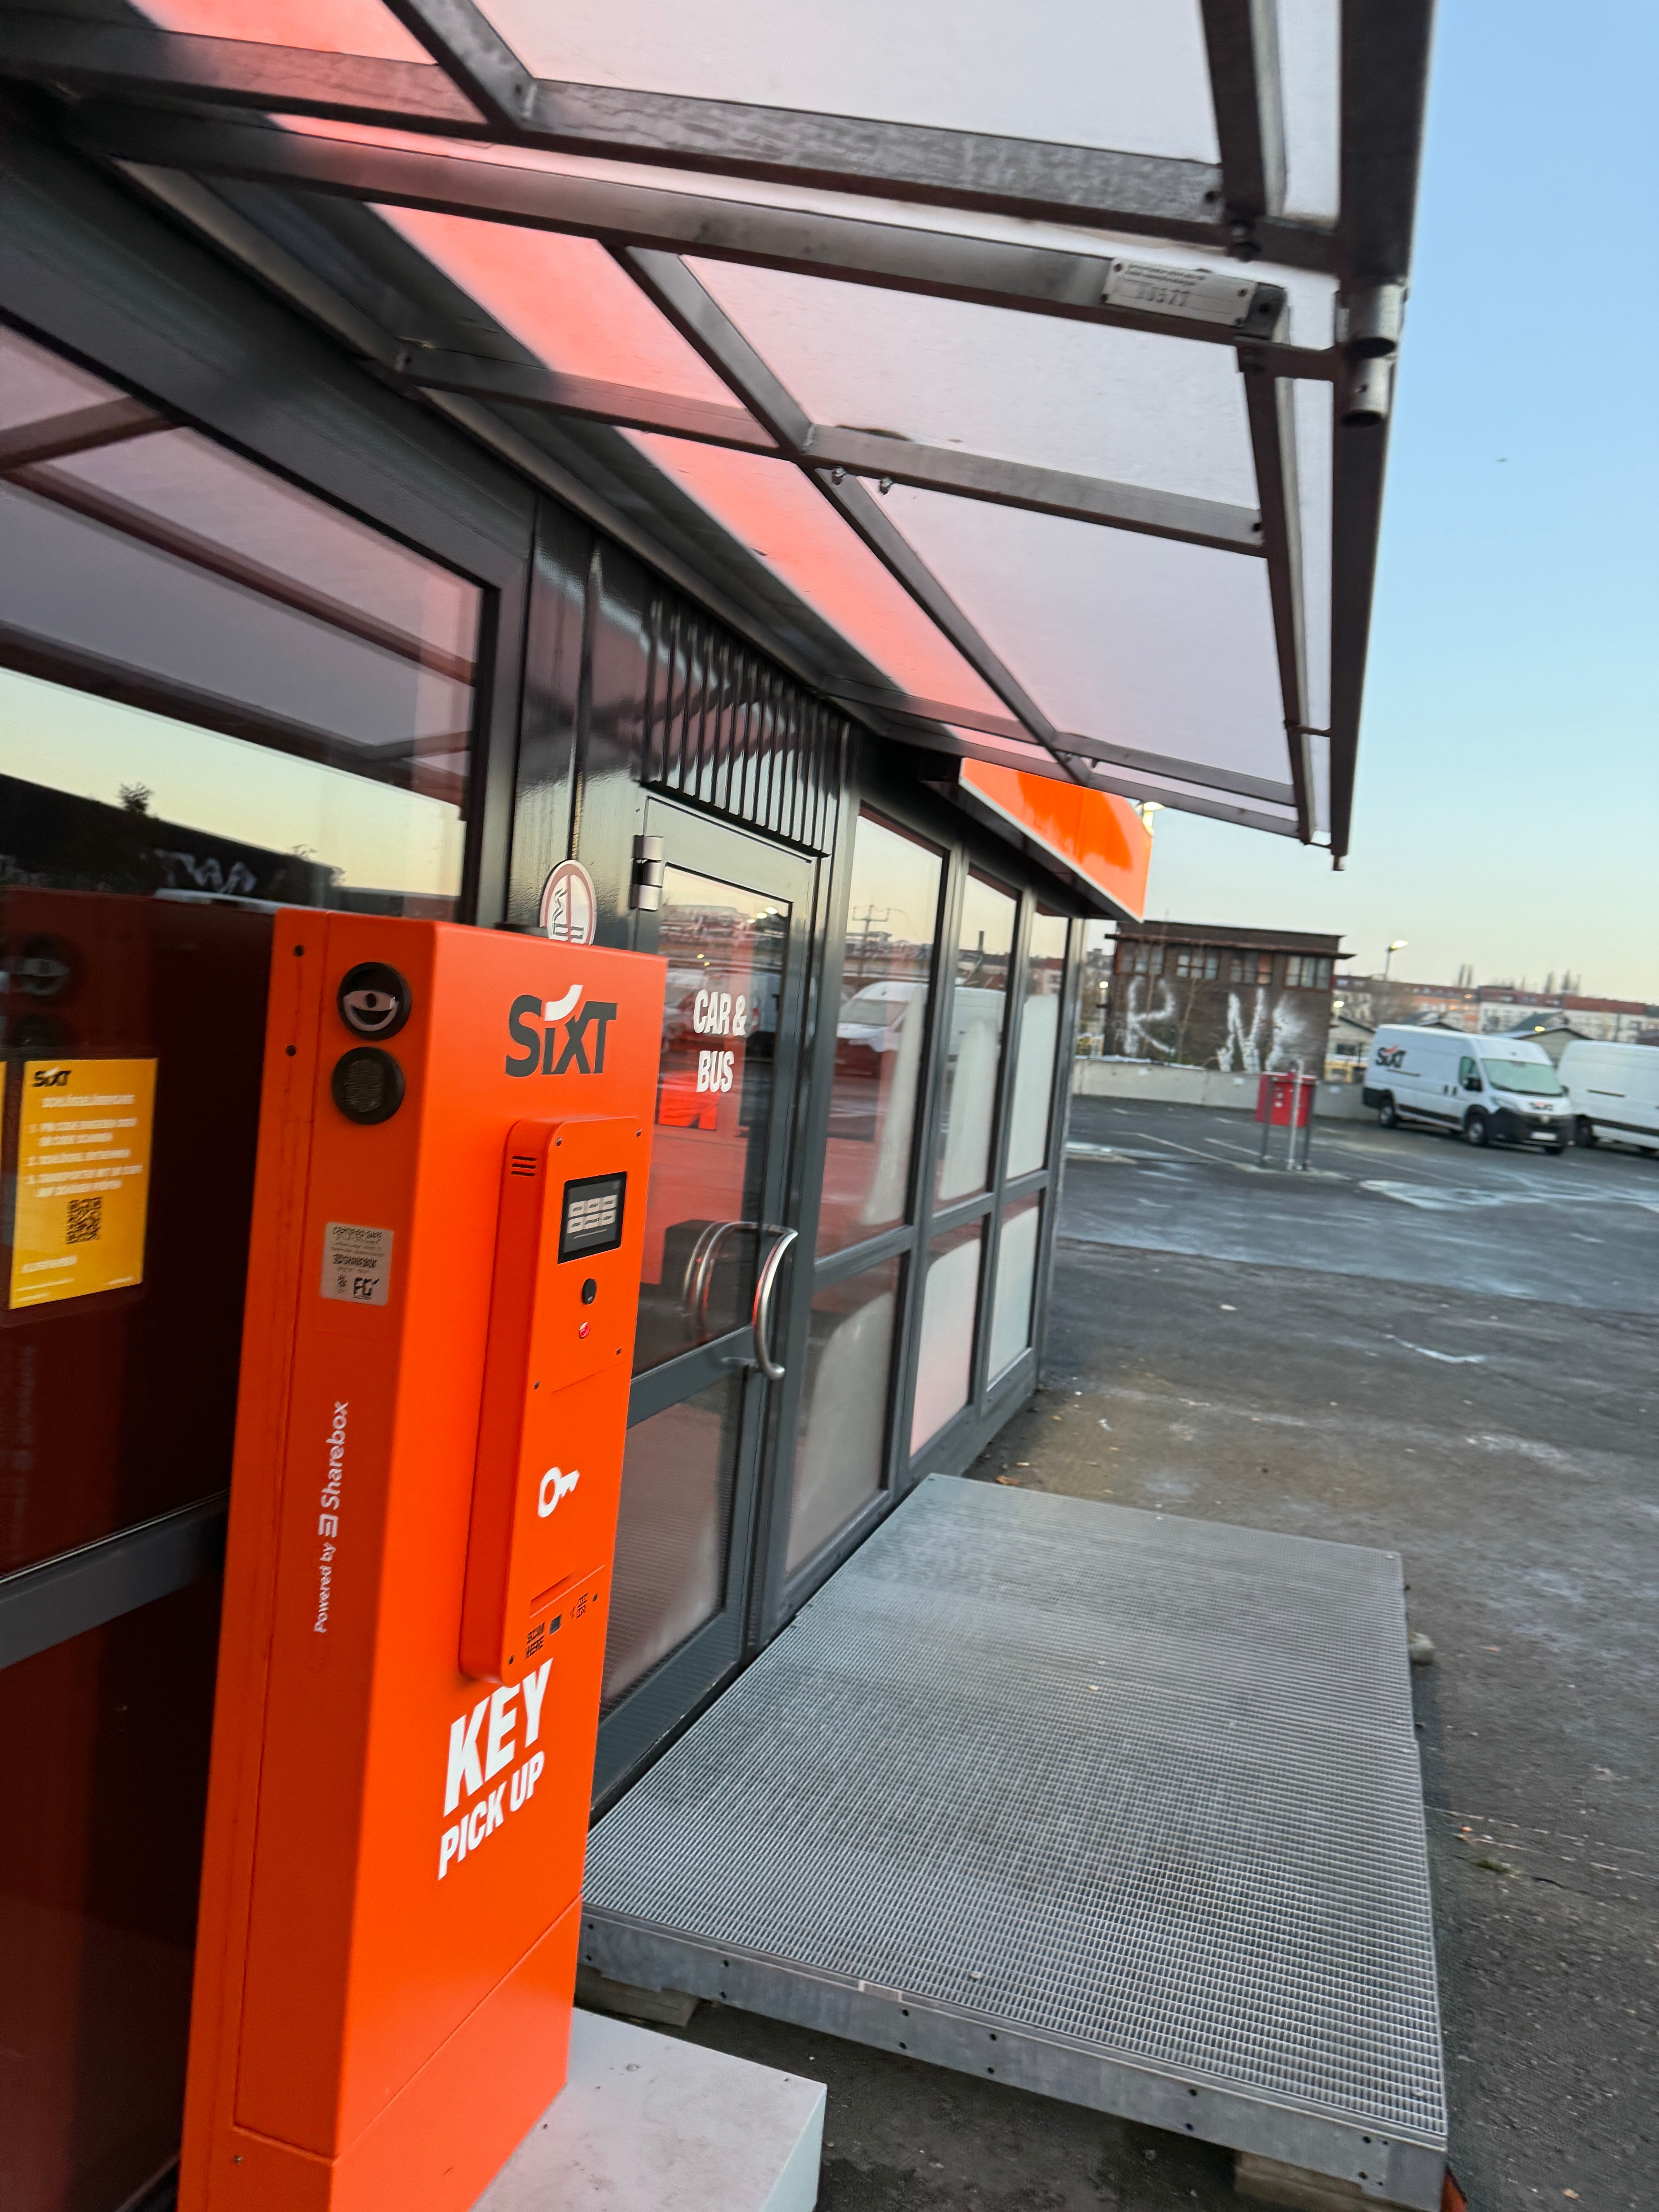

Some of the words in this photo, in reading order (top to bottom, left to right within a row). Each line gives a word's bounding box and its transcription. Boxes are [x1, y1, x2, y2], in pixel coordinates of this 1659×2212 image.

[694, 989, 732, 1035] CAR
[733, 995, 747, 1036] &
[696, 1051, 734, 1092] BUS
[321, 1401, 349, 1510] Sharebox
[320, 1542, 337, 1562] by
[314, 1565, 332, 1633] Powered
[443, 1657, 553, 1817] KEY
[438, 1781, 507, 1881] PICK
[510, 1750, 545, 1812] UP
